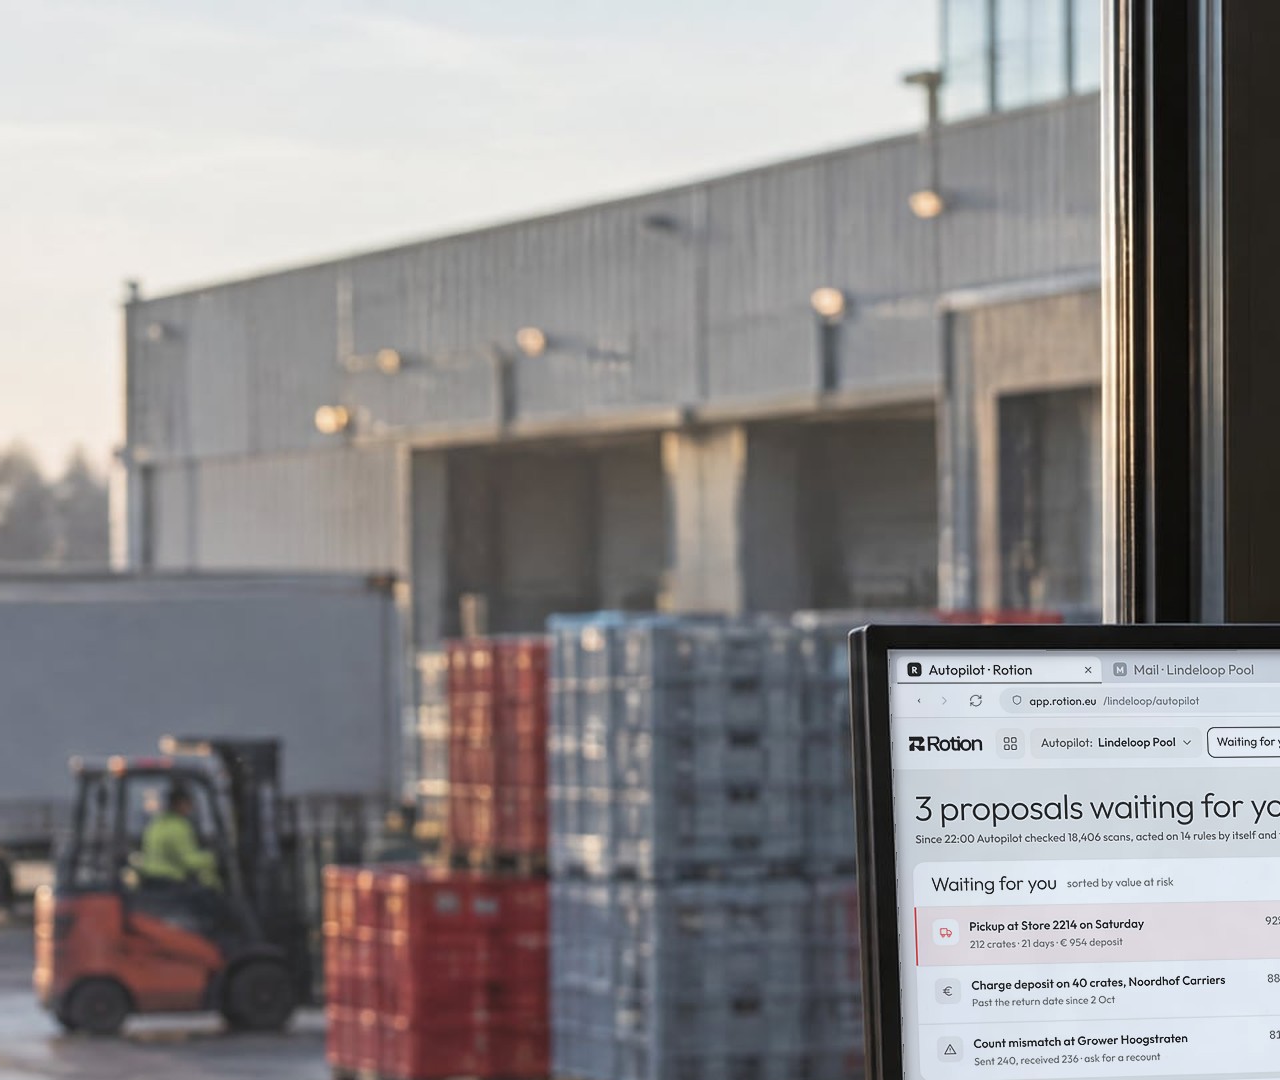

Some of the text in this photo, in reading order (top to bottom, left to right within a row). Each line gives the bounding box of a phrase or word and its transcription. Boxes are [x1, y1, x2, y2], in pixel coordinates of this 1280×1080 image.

[928, 664, 1032, 678] Autopilot Rotion
[1134, 664, 1254, 678] Mail Lindeloop Pool
[1029, 696, 1096, 708] app.rotion.eu
[1103, 695, 1199, 708] /lindeloop/autopilot
[927, 735, 983, 752] Rotion
[1040, 736, 1176, 750] Autopilot: Lindeloop Pool
[1216, 736, 1257, 749] Waiting
[1259, 736, 1276, 747] for
[915, 795, 932, 822] 3
[940, 793, 1083, 828] proposals
[1089, 794, 1193, 825] waiting
[1200, 792, 1244, 818] for
[931, 875, 1057, 895] Waiting for you
[1066, 876, 1174, 890] sorted by value at risk
[969, 918, 1144, 933] Pickup at Store 2214 on Saturday
[969, 937, 1123, 949] 212 crates 21 days € 954 deposit
[973, 1033, 1188, 1049] Count mismatch at Grower Hoogstraten
